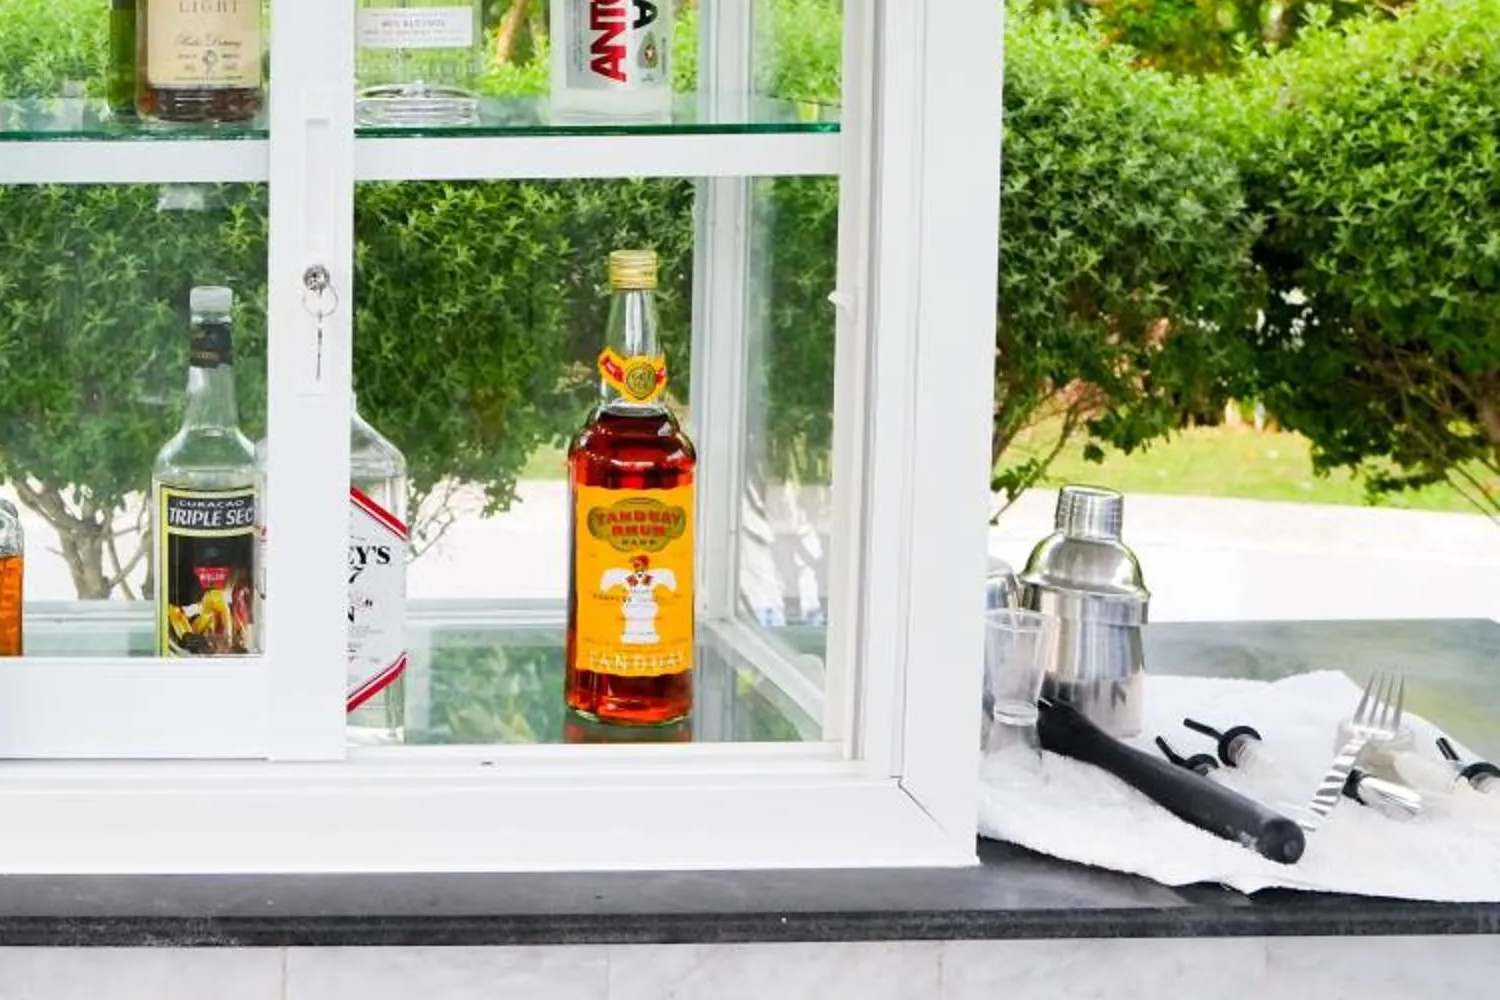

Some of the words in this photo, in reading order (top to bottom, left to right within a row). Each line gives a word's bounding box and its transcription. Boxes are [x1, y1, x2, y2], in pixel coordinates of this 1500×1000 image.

[169, 507, 223, 527] TRIPLE
[225, 508, 254, 526] SEC
[594, 509, 682, 526] TANDUAY
